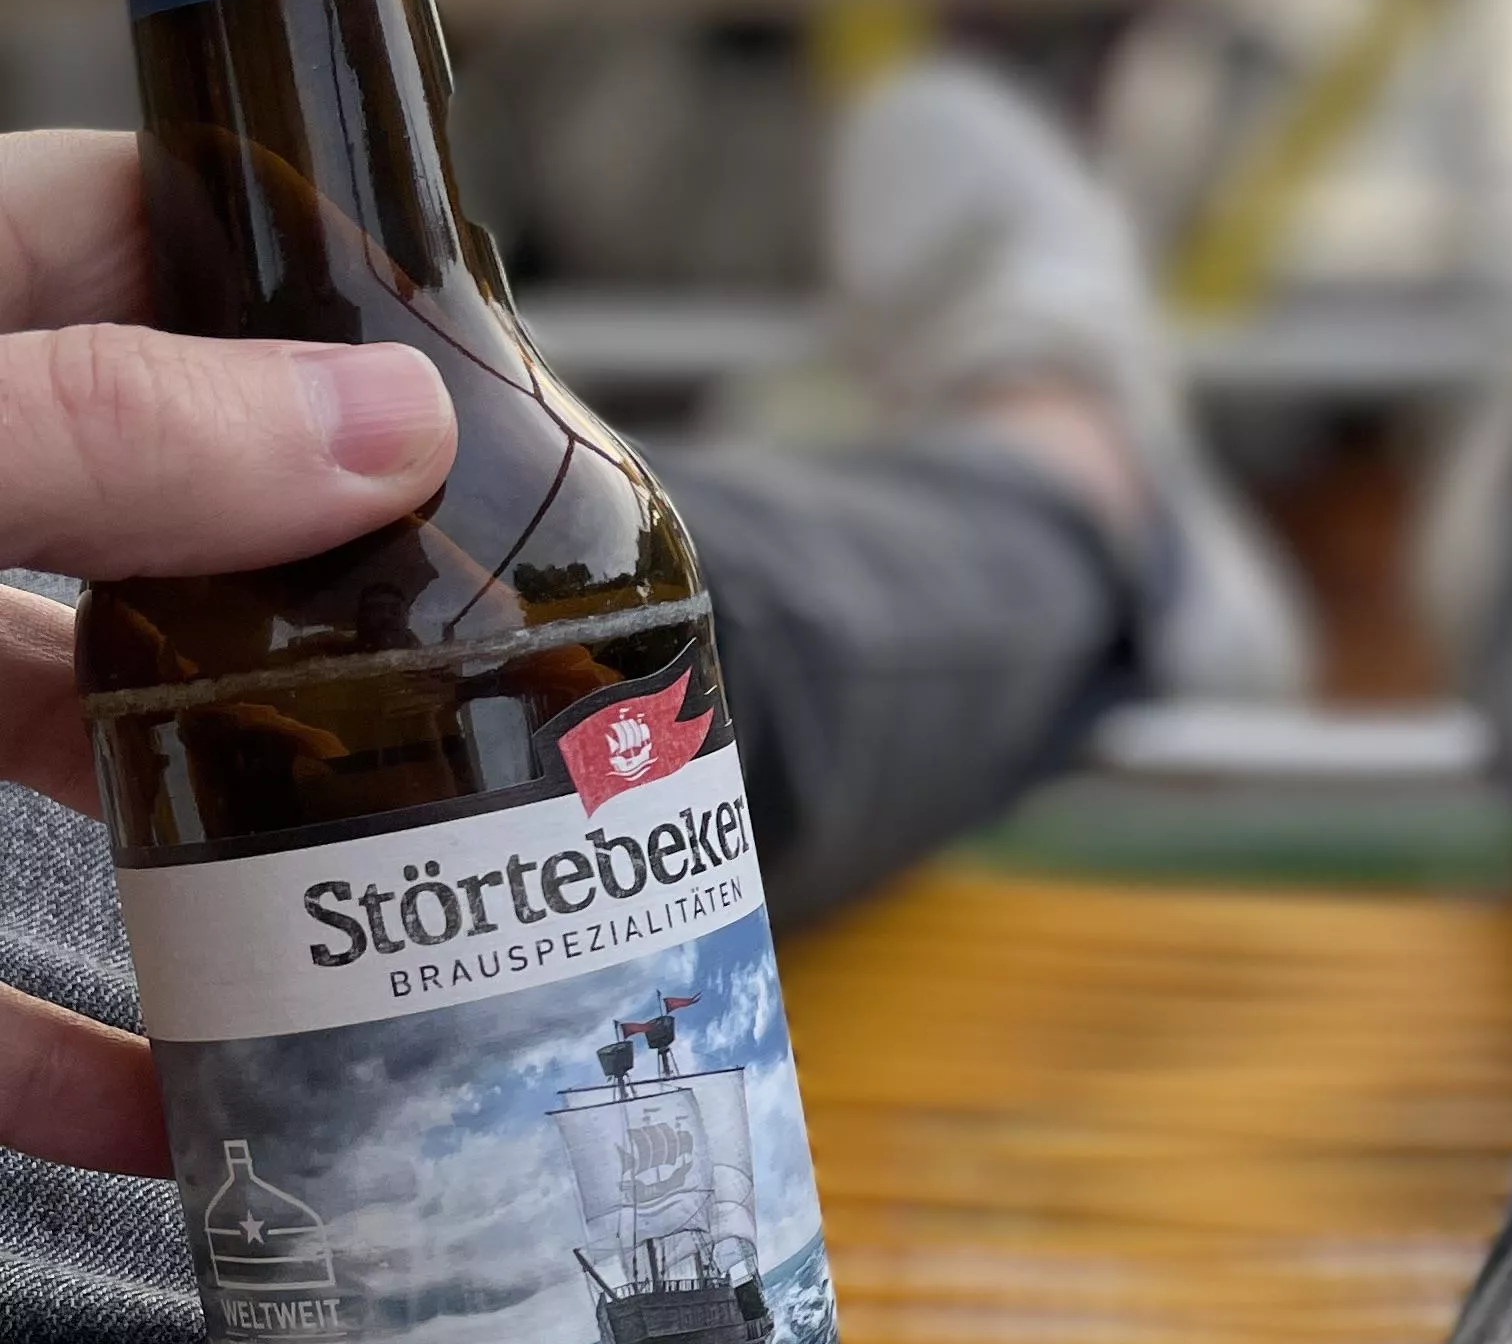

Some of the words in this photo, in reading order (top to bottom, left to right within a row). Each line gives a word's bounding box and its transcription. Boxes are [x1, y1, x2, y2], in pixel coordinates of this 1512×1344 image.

[303, 794, 750, 968] Störtebeker
[389, 875, 744, 998] BRAUSPEZIALITÄTEN
[220, 1298, 340, 1330] WELTWEIT
